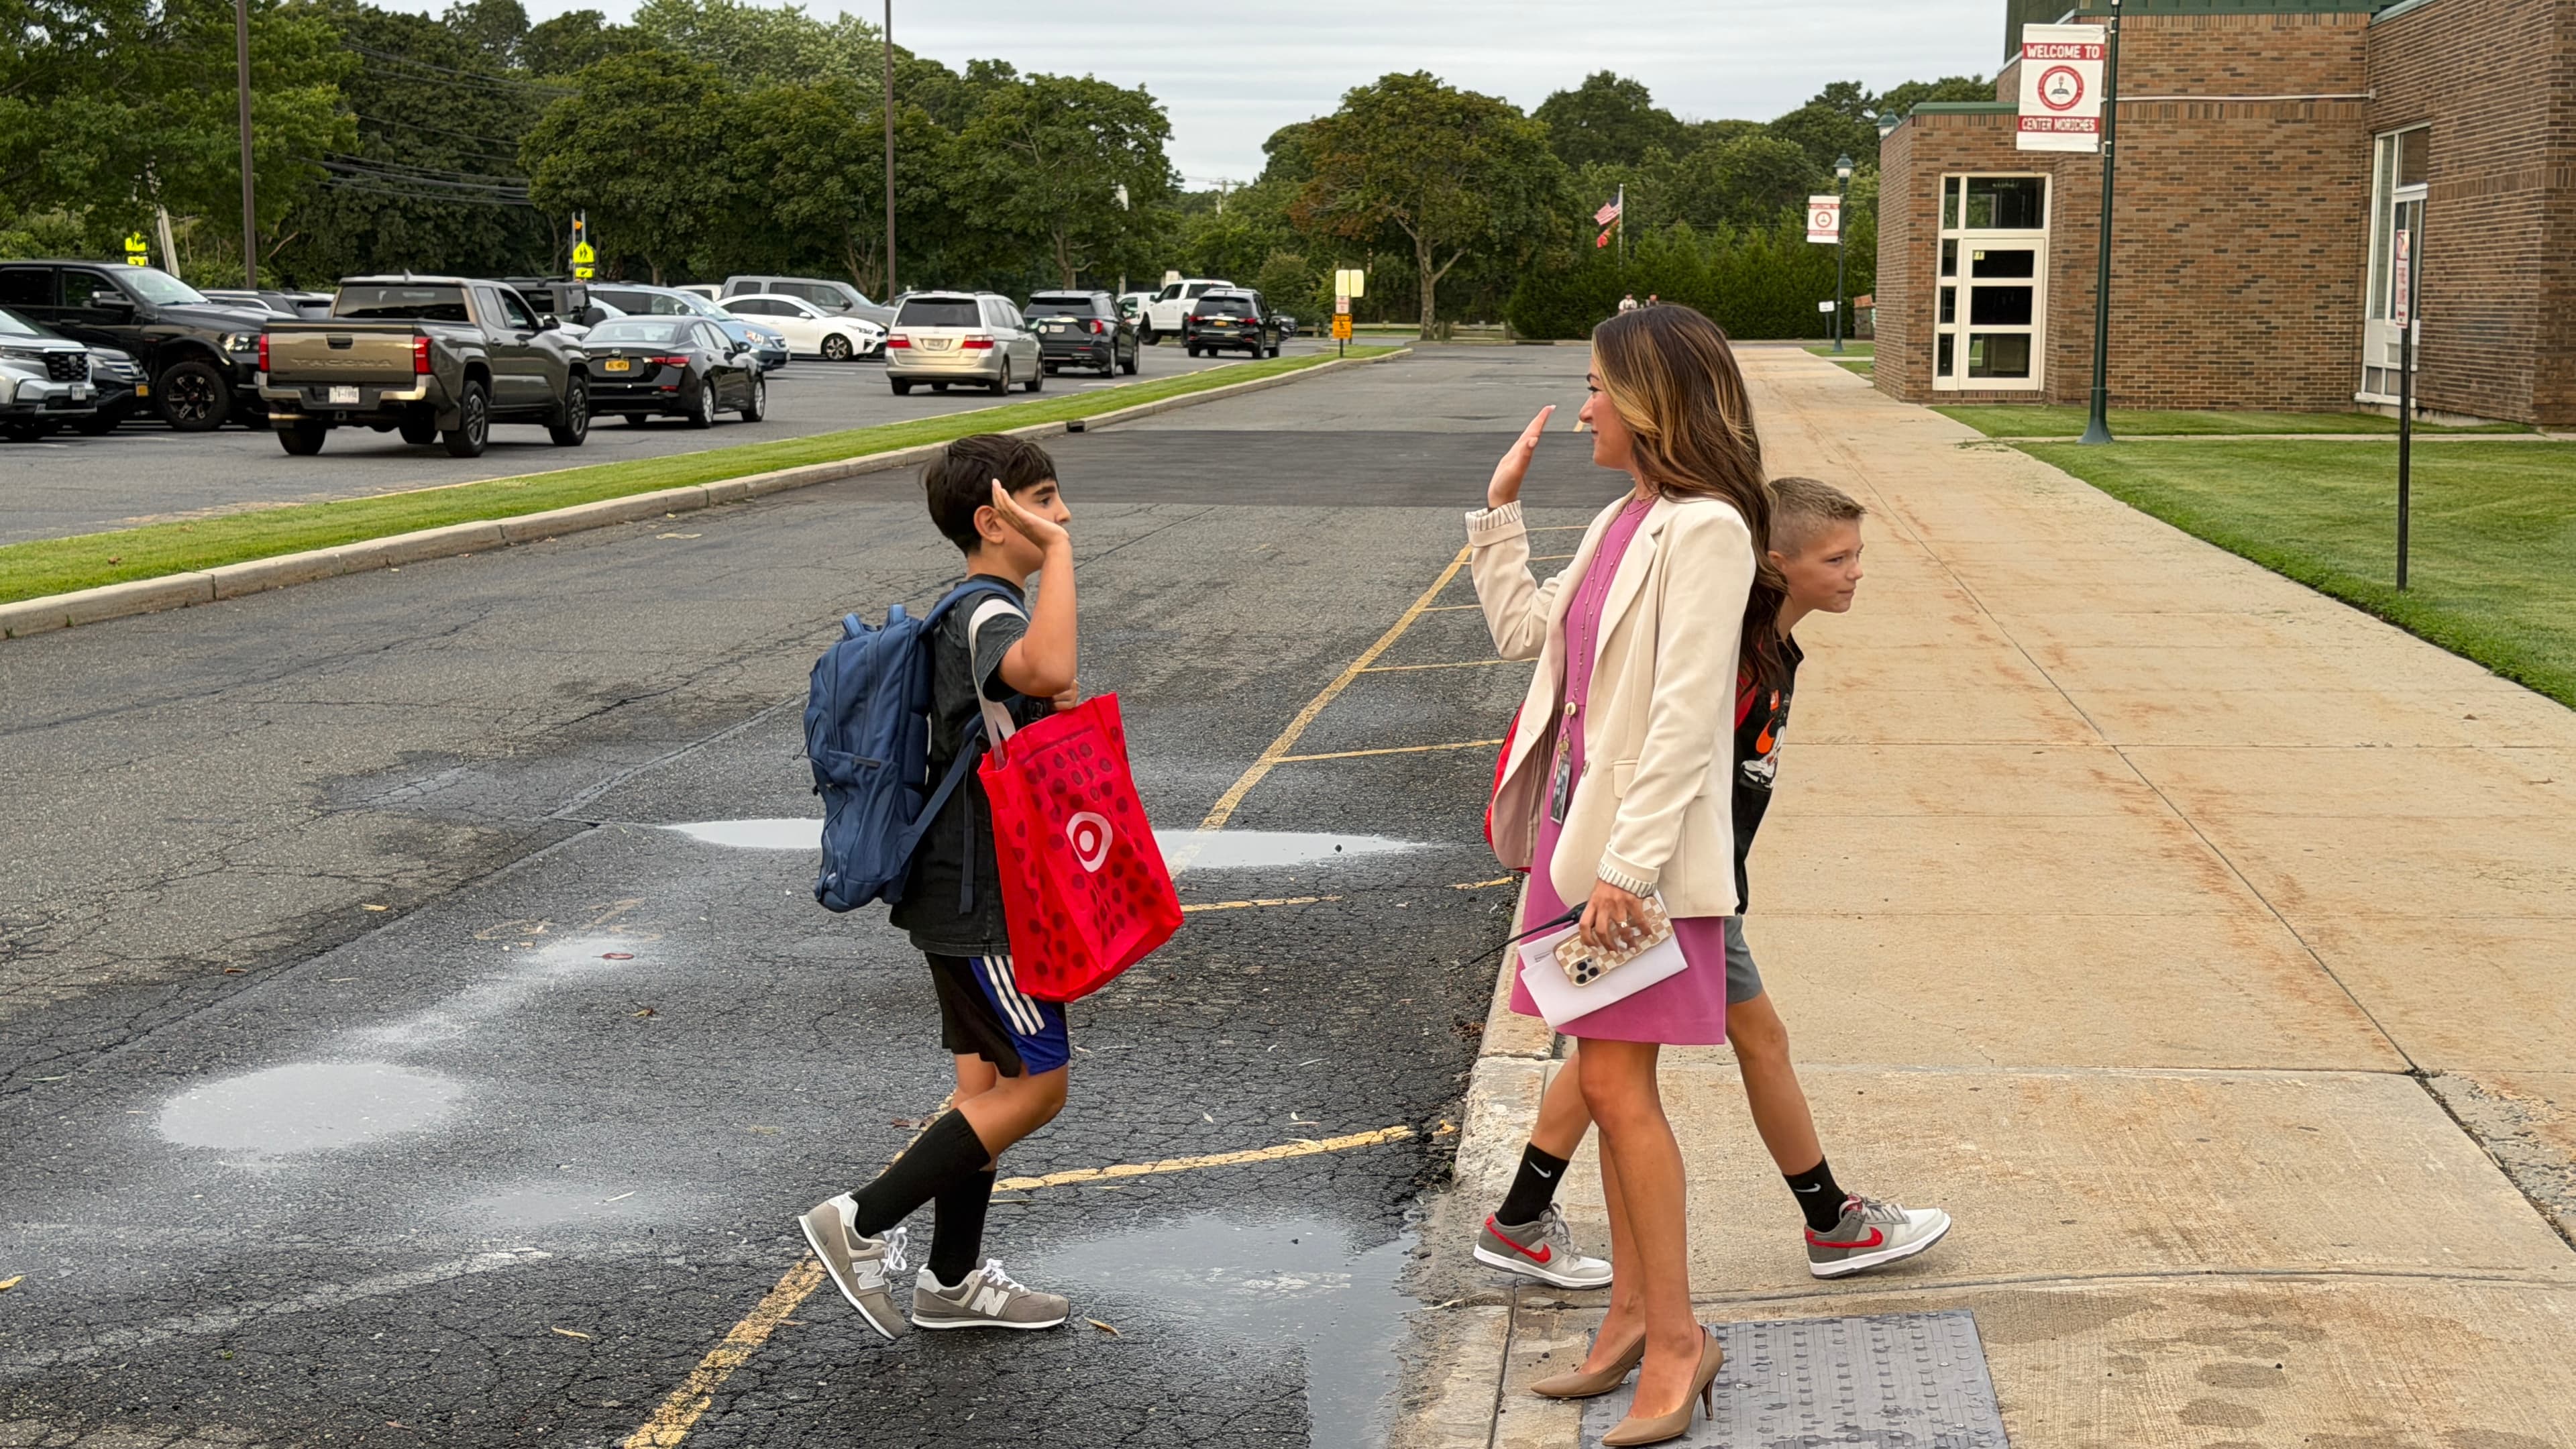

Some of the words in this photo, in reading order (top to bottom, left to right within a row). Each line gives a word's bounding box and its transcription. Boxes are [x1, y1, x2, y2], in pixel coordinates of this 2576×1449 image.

[2026, 44, 2080, 59] WELCOME
[2084, 45, 2100, 59] TO
[2021, 117, 2052, 131] CENTER
[290, 358, 392, 368] TACOMA
[853, 1259, 885, 1290] N
[970, 1285, 1010, 1317] N
